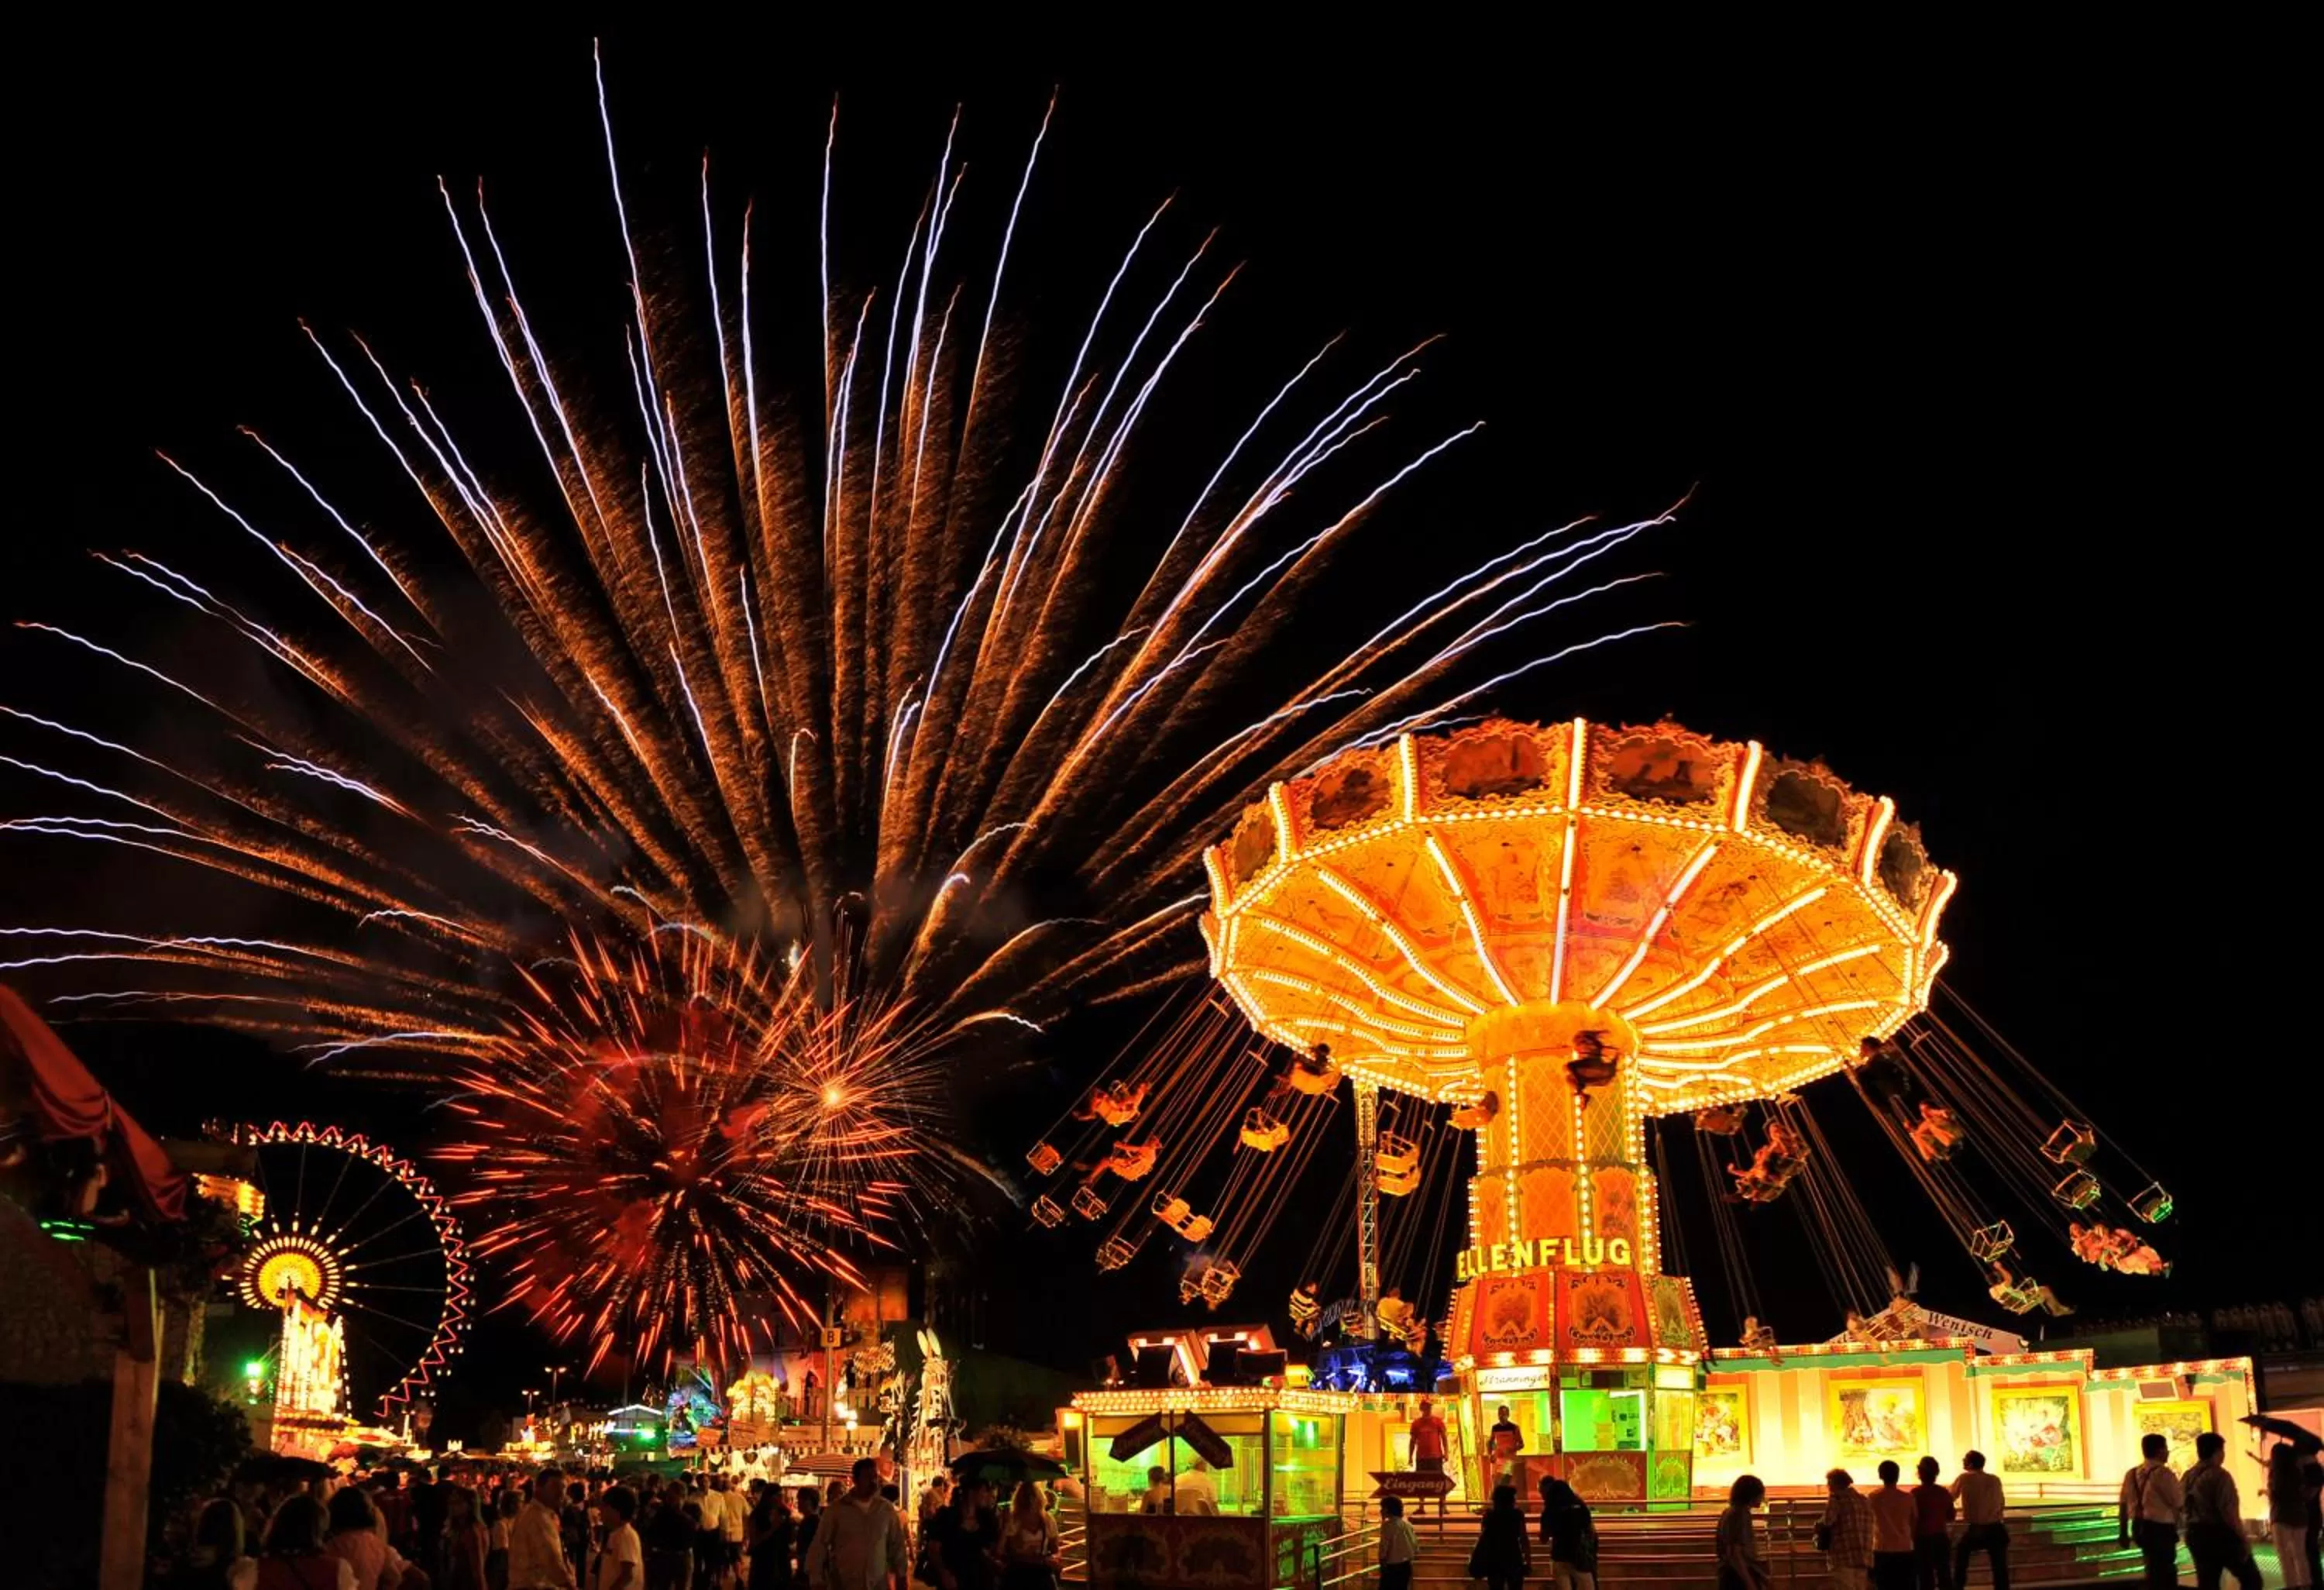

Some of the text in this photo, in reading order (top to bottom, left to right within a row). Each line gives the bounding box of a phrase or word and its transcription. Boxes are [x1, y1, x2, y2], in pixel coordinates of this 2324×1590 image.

[1456, 1237, 1631, 1279] ELLENFLUG
[1928, 1312, 1993, 1339] Wenisch
[1384, 1477, 1445, 1493] Eingang
